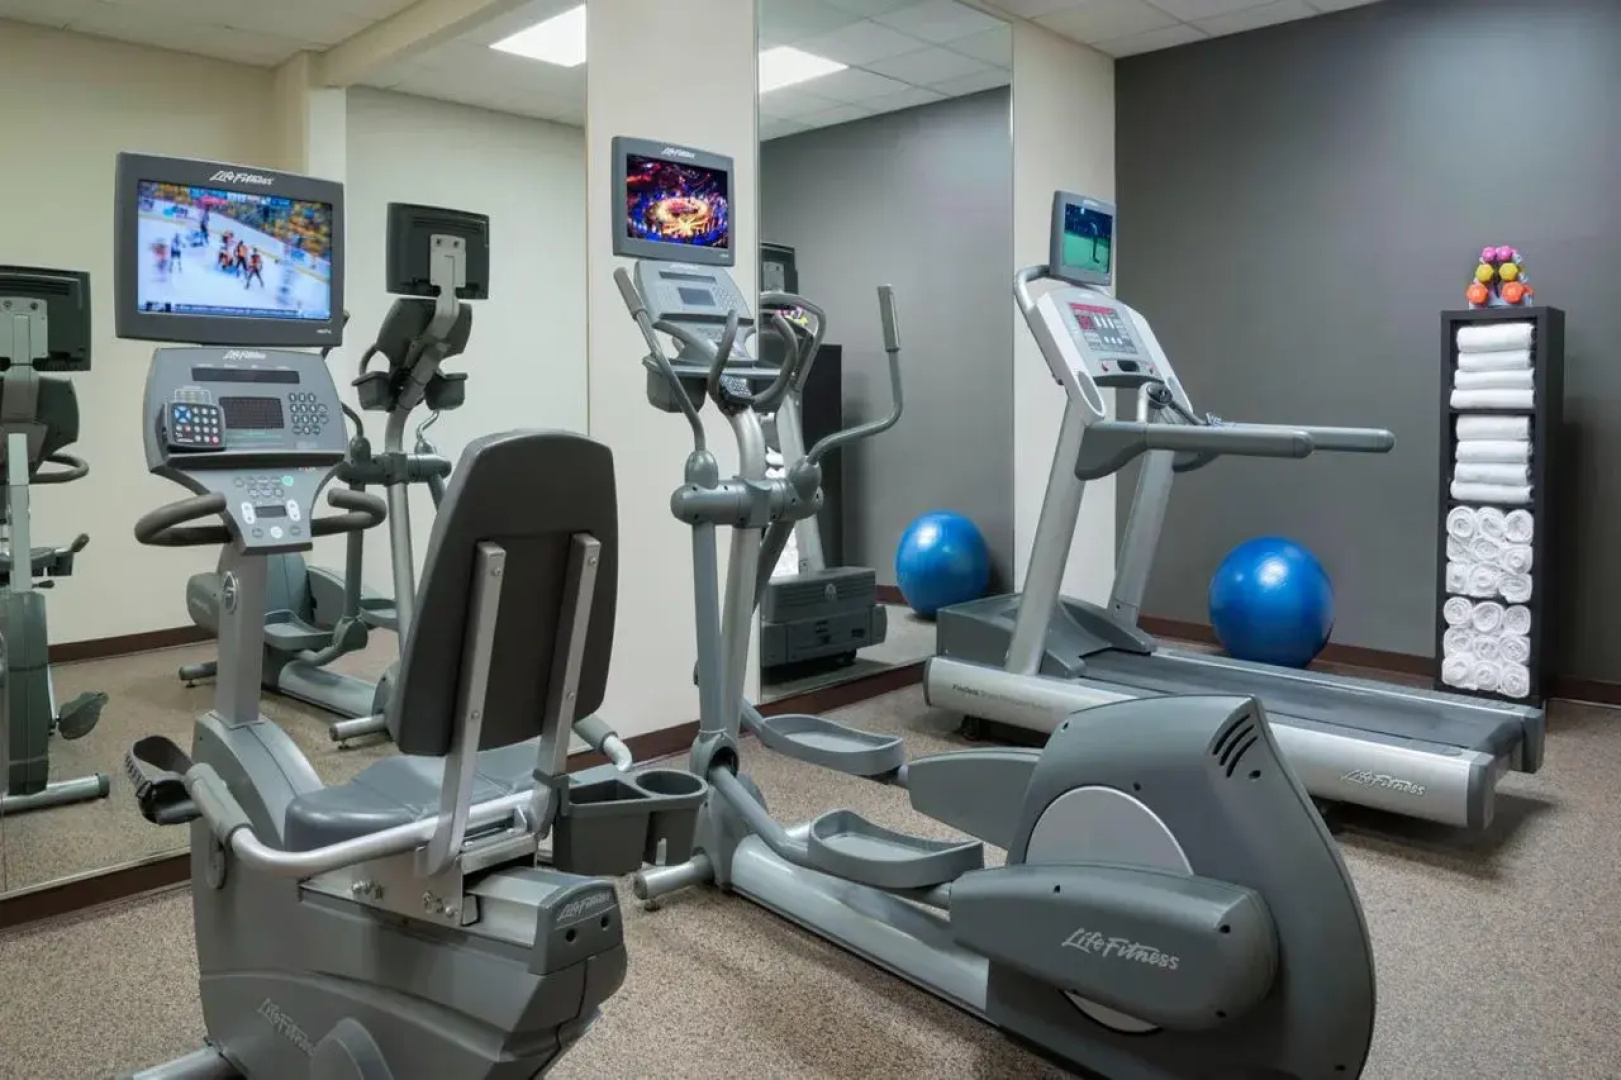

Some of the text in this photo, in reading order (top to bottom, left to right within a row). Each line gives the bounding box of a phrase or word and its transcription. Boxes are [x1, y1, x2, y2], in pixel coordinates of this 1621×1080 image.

[209, 170, 235, 182] Life
[1370, 774, 1427, 796] Fitness
[1061, 927, 1180, 971] Life Fitness
